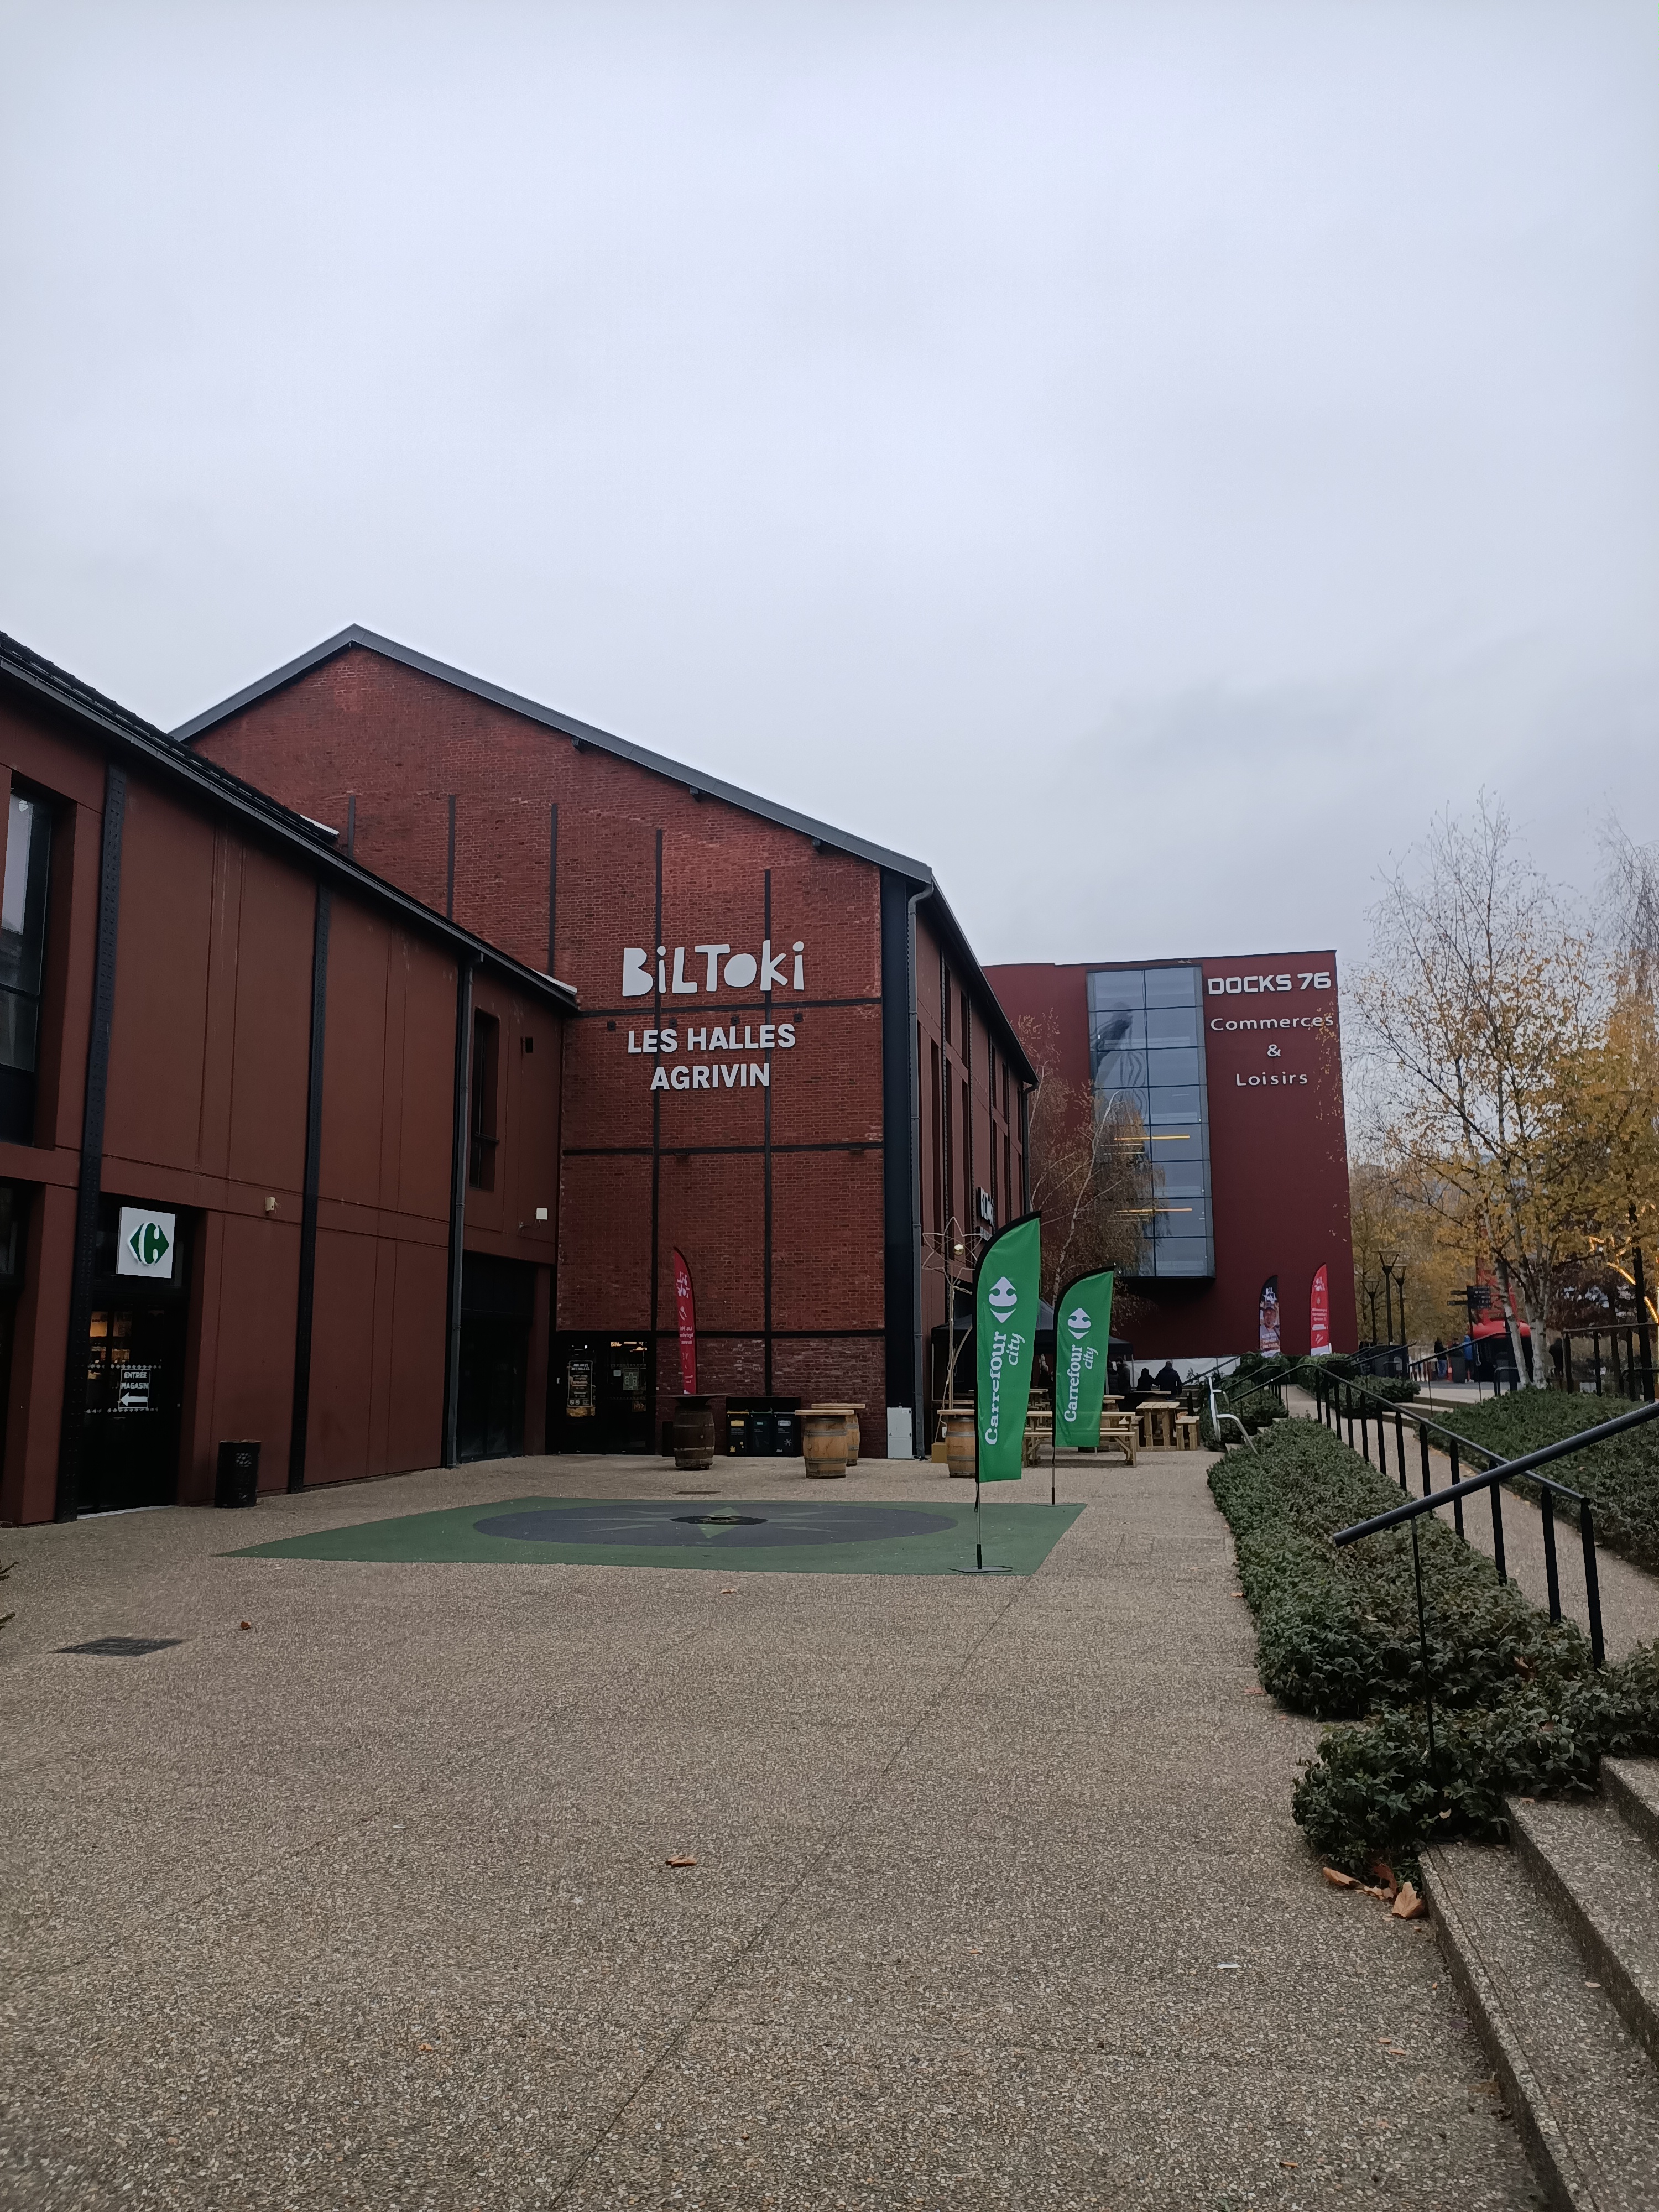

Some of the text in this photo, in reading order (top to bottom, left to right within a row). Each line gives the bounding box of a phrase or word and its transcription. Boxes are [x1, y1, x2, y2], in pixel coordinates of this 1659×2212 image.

[1208, 972, 1331, 995] DOCKS 76
[1211, 1015, 1334, 1031] Commerces
[628, 1023, 796, 1053] LES HALLES
[1267, 1044, 1281, 1057] &
[650, 1062, 770, 1091] AGRIVIN
[1236, 1071, 1308, 1087] Loisirs
[1004, 1333, 1025, 1366] city
[1083, 1347, 1099, 1369] city
[124, 1370, 148, 1379] ENTRÉE
[1064, 1344, 1083, 1422] Carrefour
[985, 1331, 1006, 1445] Carrefour
